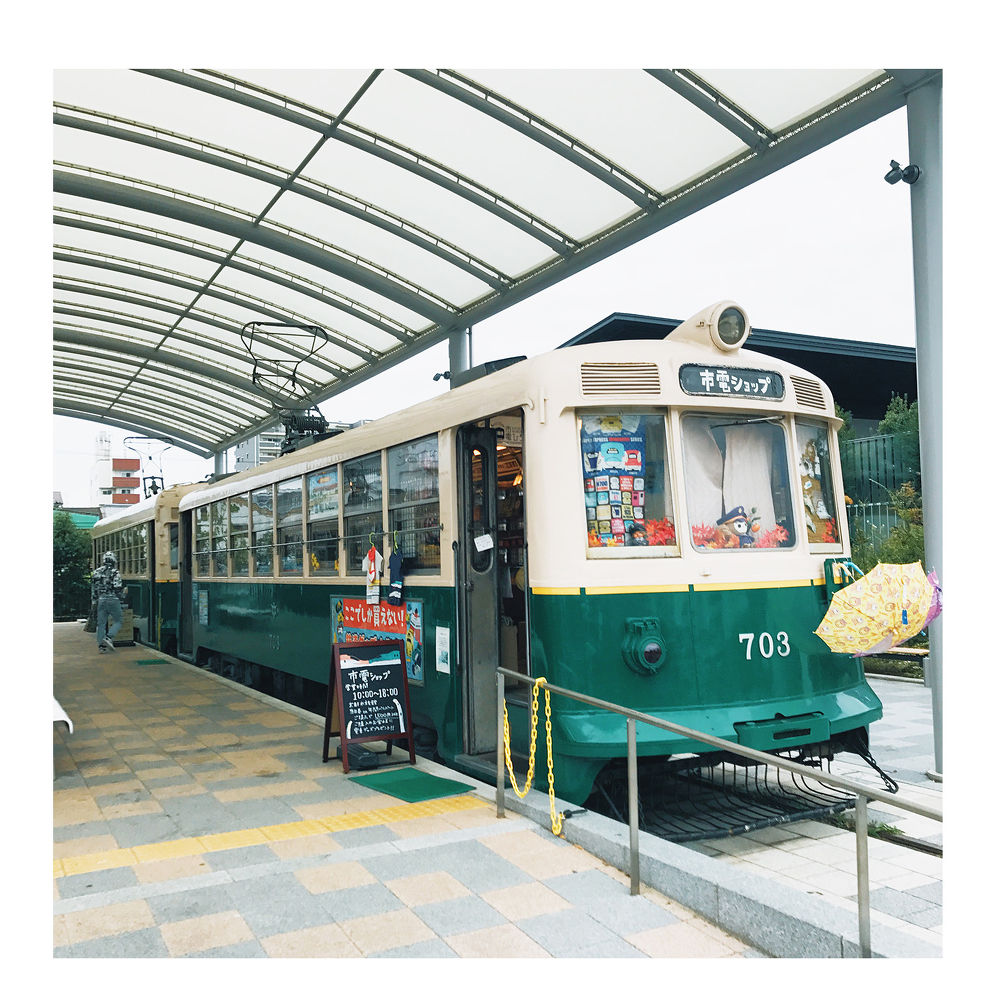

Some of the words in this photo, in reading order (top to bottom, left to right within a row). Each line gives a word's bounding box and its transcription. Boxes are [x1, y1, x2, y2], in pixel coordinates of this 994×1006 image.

[699, 368, 771, 393] 市電ショップ
[345, 606, 404, 627] ここでしか買えない!
[738, 631, 791, 660] 703
